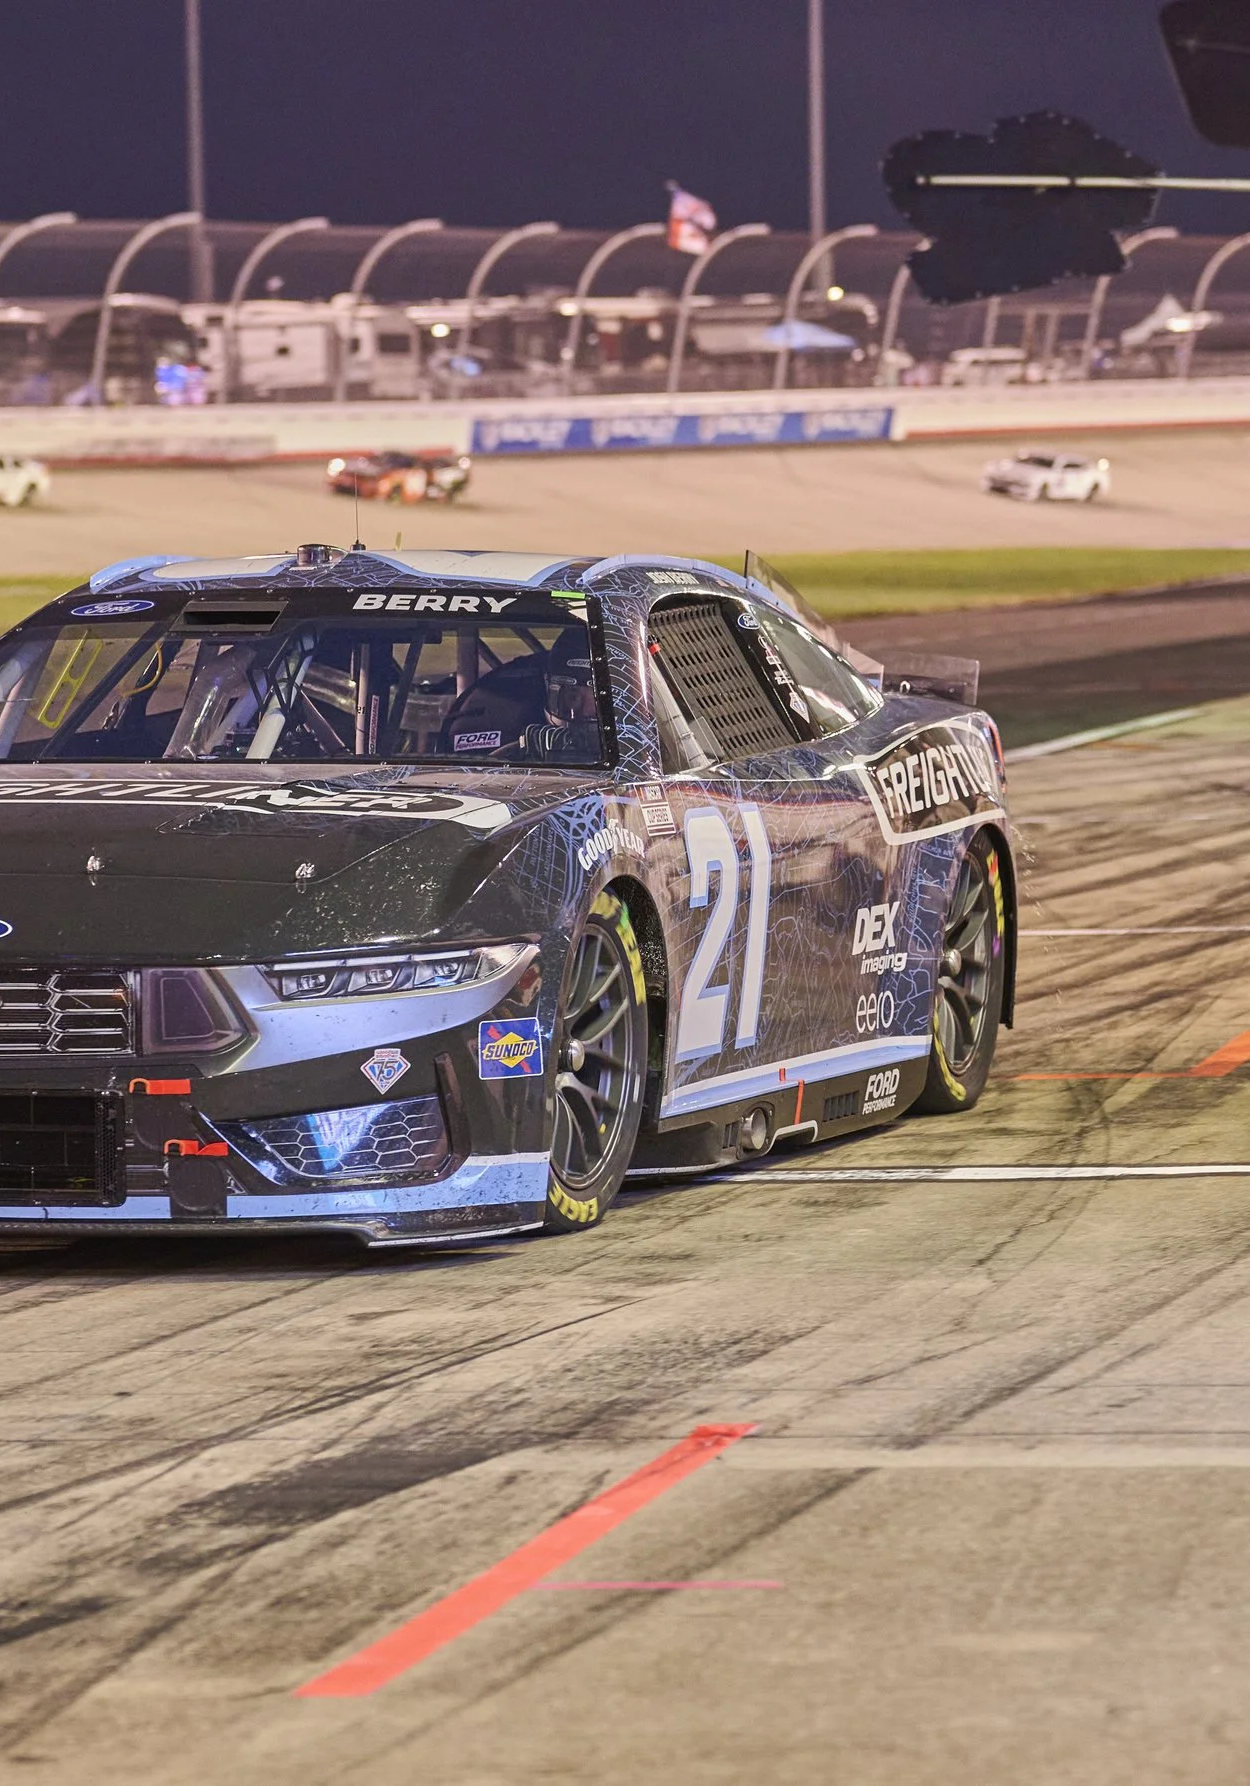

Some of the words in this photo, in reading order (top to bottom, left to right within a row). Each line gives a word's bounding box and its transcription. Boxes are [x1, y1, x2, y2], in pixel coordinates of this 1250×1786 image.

[84, 600, 141, 615] Ford
[352, 594, 517, 613] BERRY
[457, 732, 499, 744] FORD
[578, 819, 645, 871] GOODYEAR
[675, 802, 771, 1064] 21
[852, 901, 900, 955] DEX
[860, 950, 907, 975] imaging
[855, 990, 894, 1033] eero
[486, 1041, 535, 1059] SUNOCO
[373, 1060, 399, 1081] 75
[865, 1068, 900, 1101] FORD
[862, 1094, 897, 1115] PERFORMANCE
